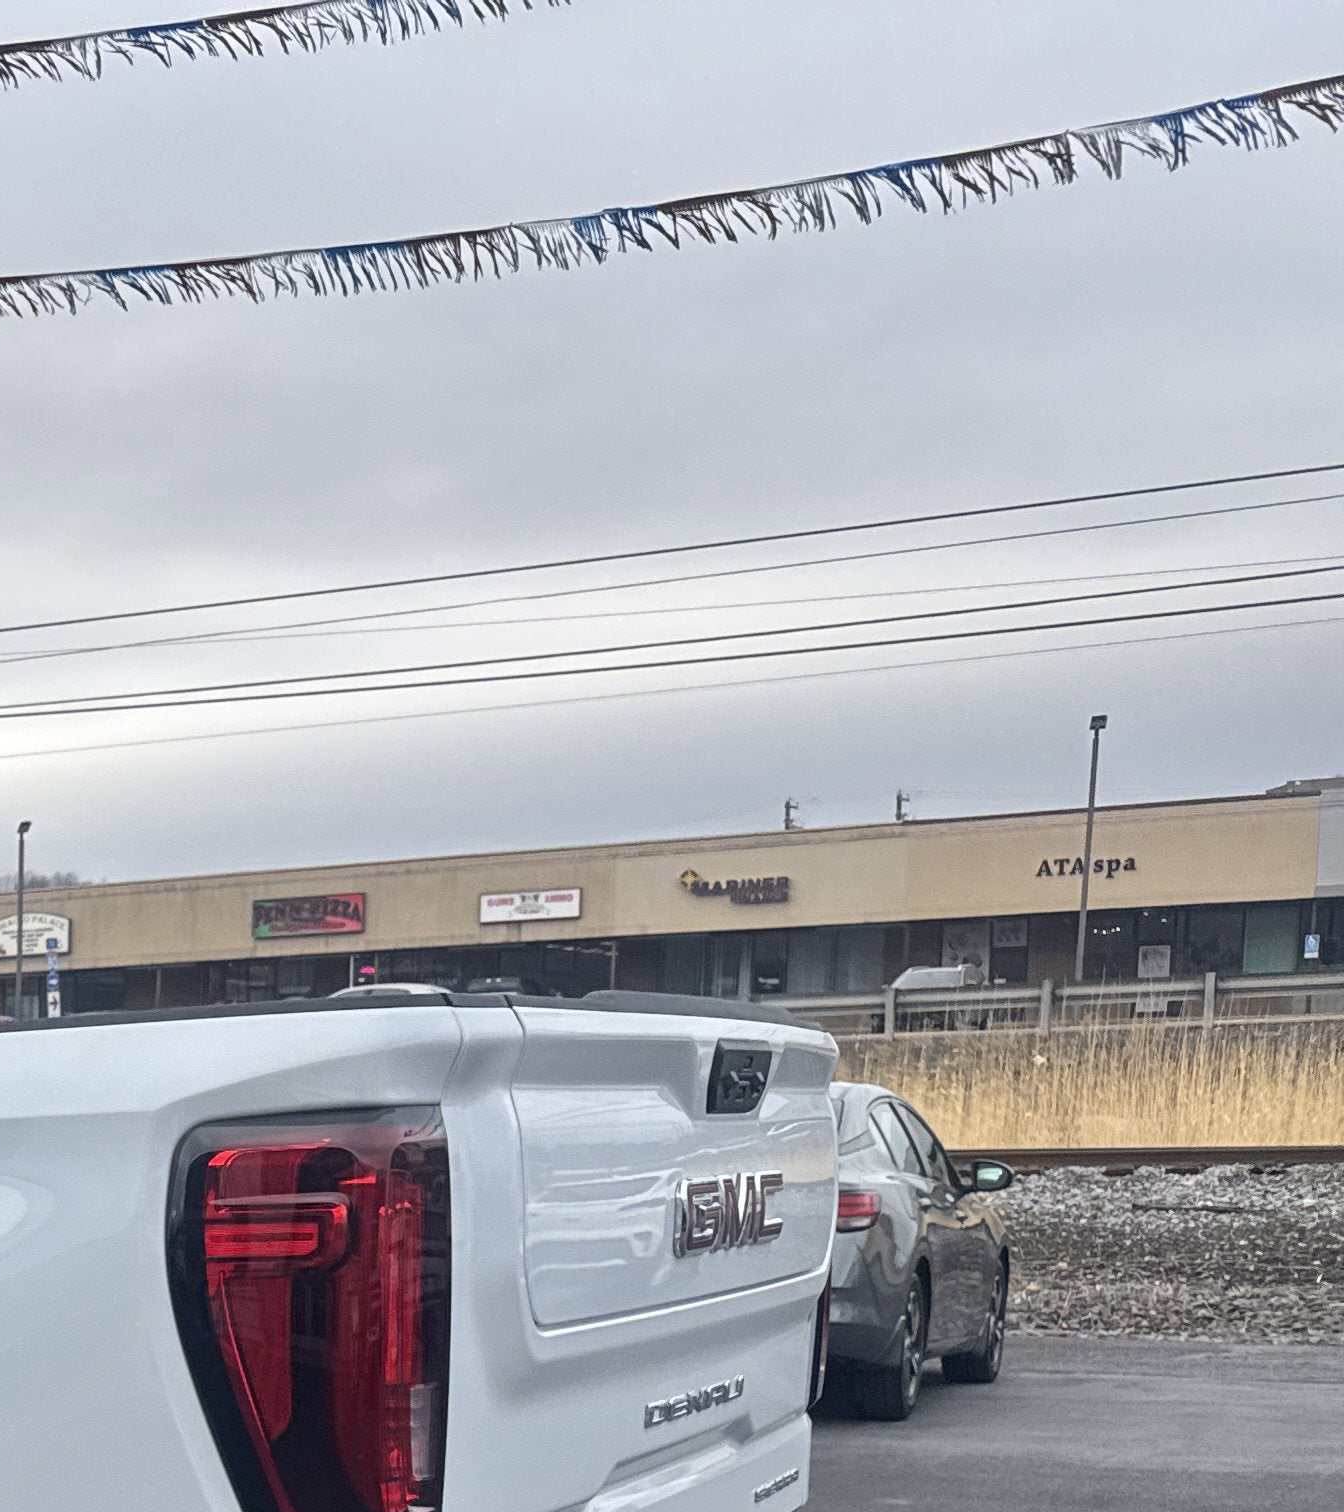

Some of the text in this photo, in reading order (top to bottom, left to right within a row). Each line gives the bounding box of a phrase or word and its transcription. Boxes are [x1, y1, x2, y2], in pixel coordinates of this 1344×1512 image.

[1035, 857, 1137, 879] ATA spa
[673, 1169, 784, 1259] GMC
[643, 1374, 745, 1430] DENALI
